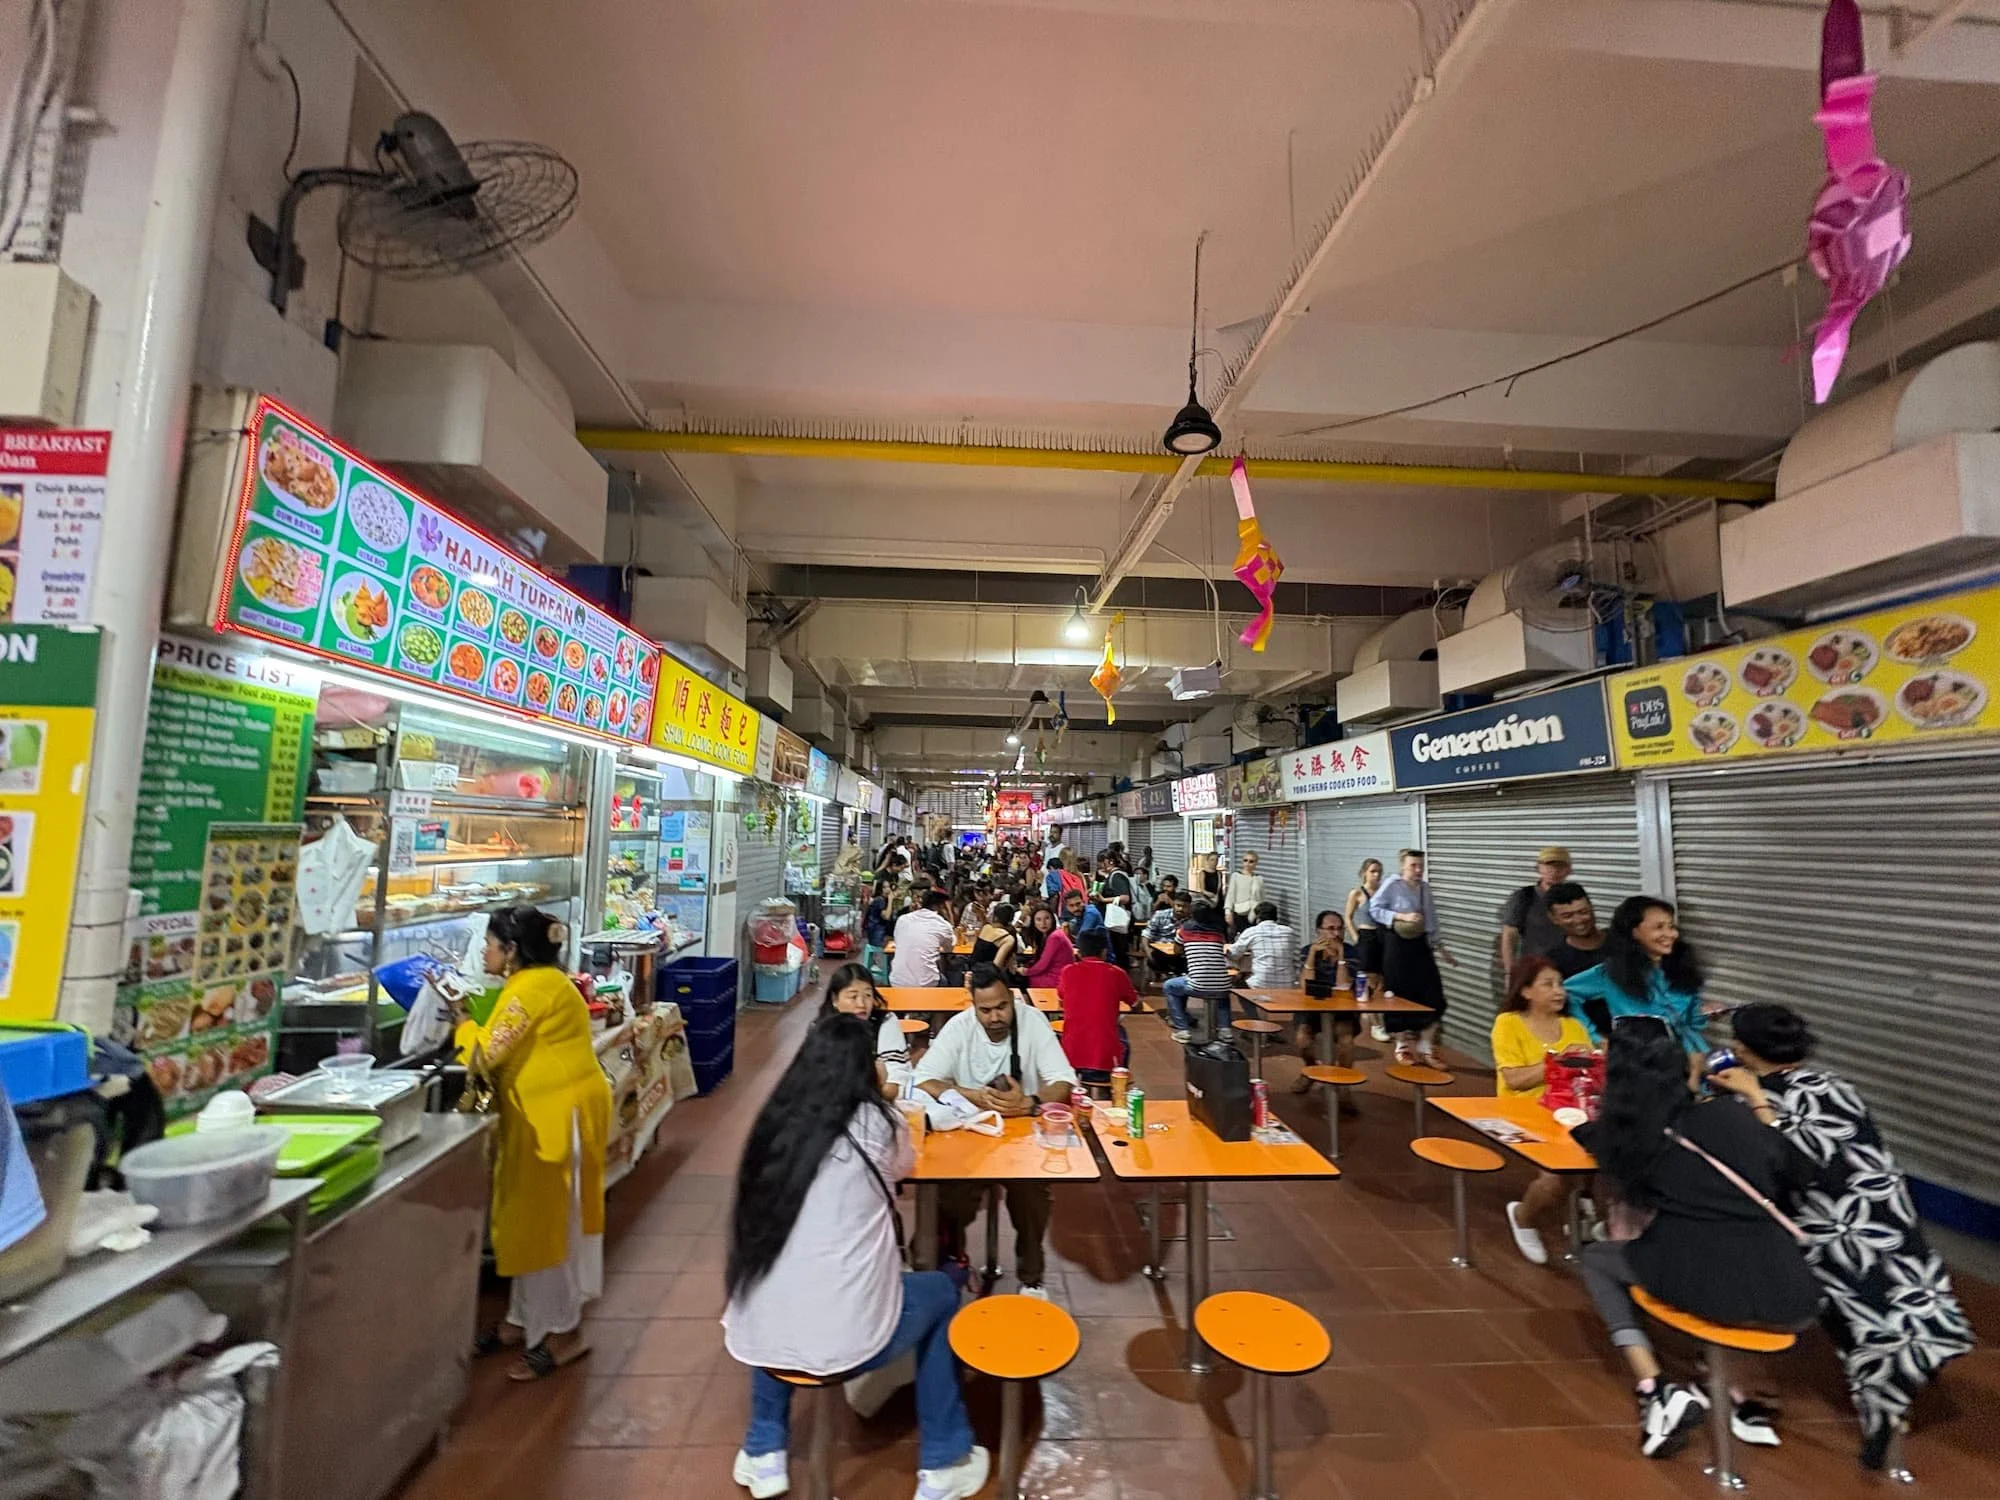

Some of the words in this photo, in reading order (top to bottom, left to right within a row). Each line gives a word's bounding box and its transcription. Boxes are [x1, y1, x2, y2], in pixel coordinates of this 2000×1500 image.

[4, 433, 107, 453] BREAKFAST
[445, 537, 515, 593] HAJIAH
[519, 580, 573, 626] TURFAN
[158, 639, 237, 675] PRICE
[246, 665, 295, 687] LIST
[1640, 698, 1665, 714] DBS
[1412, 713, 1565, 763] Generation
[1455, 761, 1500, 775] COFFEE
[1308, 782, 1328, 793] SHENG
[1329, 777, 1356, 791] COOKED
[1357, 775, 1377, 787] FOOD
